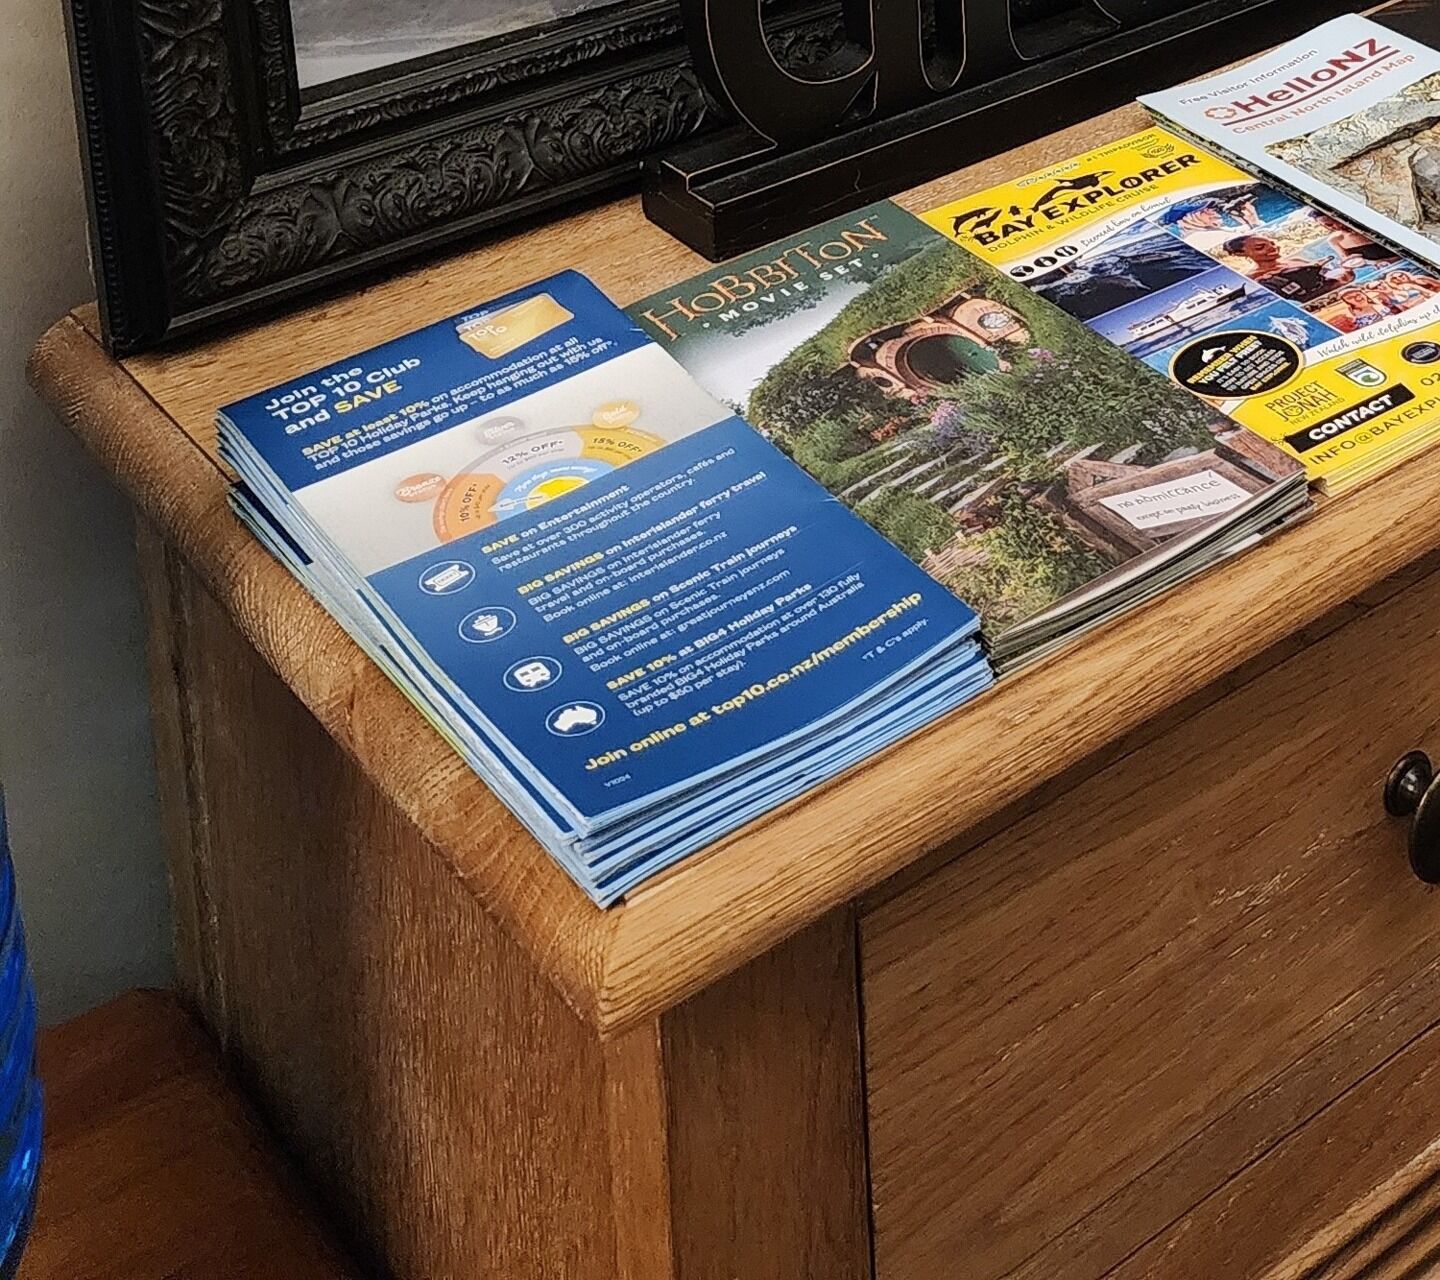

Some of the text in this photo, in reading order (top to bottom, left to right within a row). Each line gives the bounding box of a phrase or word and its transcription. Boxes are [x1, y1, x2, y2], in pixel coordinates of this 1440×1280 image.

[1178, 50, 1317, 105] Free Visitor Information
[1232, 38, 1389, 112] HelloNZ
[1232, 54, 1415, 134] Central North Island Map
[973, 215, 1034, 245] BAY
[987, 228, 1044, 252] DOLPHIN
[1055, 200, 1115, 225] WILDLIFE
[1115, 184, 1159, 203] CRUISE
[645, 220, 885, 338] HOBBITON
[718, 258, 862, 322] MOVIE SET
[265, 367, 362, 410] Join the
[271, 358, 420, 419] TOP 10 Club
[285, 379, 402, 434] and SAVE
[302, 336, 579, 455] SAVE at least 10% on accommodation at all
[306, 445, 339, 462] TOP
[340, 438, 358, 449] 10
[358, 418, 408, 442] Holiday
[452, 386, 486, 403] Keep
[486, 365, 537, 389] hanging
[536, 355, 559, 368] out
[558, 344, 587, 358] with
[587, 337, 603, 346] us
[314, 454, 341, 470] and
[341, 440, 381, 458] those
[382, 419, 431, 442] savings
[432, 411, 449, 423] go
[450, 403, 468, 414] up
[478, 392, 495, 401] to
[496, 385, 512, 394] as
[512, 370, 548, 387] much
[548, 363, 564, 372] as
[563, 351, 590, 365] 15%
[1264, 380, 1324, 411] PROJECT
[1309, 394, 1391, 440] CONTACT
[481, 534, 519, 554] SAVE
[520, 527, 538, 538] on
[537, 485, 629, 530] Entertainment
[491, 549, 520, 565] Save
[521, 543, 535, 552] at
[535, 531, 561, 546] over
[562, 520, 587, 534] 300
[588, 500, 628, 522] activity
[715, 448, 735, 460] and
[517, 471, 766, 594] BIG SAVINGS on Interislander ferry travel
[534, 530, 706, 613] travel and on-board purchases.
[562, 526, 797, 643] BIG SAVINGS on Scenic Train journeys
[573, 548, 785, 655] BIG SAVINGS on Scenic Train journeys
[589, 654, 622, 672] Book
[623, 637, 658, 657] online
[659, 628, 676, 640] at:
[606, 583, 812, 689] SAVE 10% at BIG4 Holiday Parks
[617, 572, 860, 701] SAVE 10% on accommodation at over 130 fully
[625, 582, 864, 708] branded BIG4 Holiday Parks around Australia
[585, 593, 921, 770] Join online at top10.co.nz/membership
